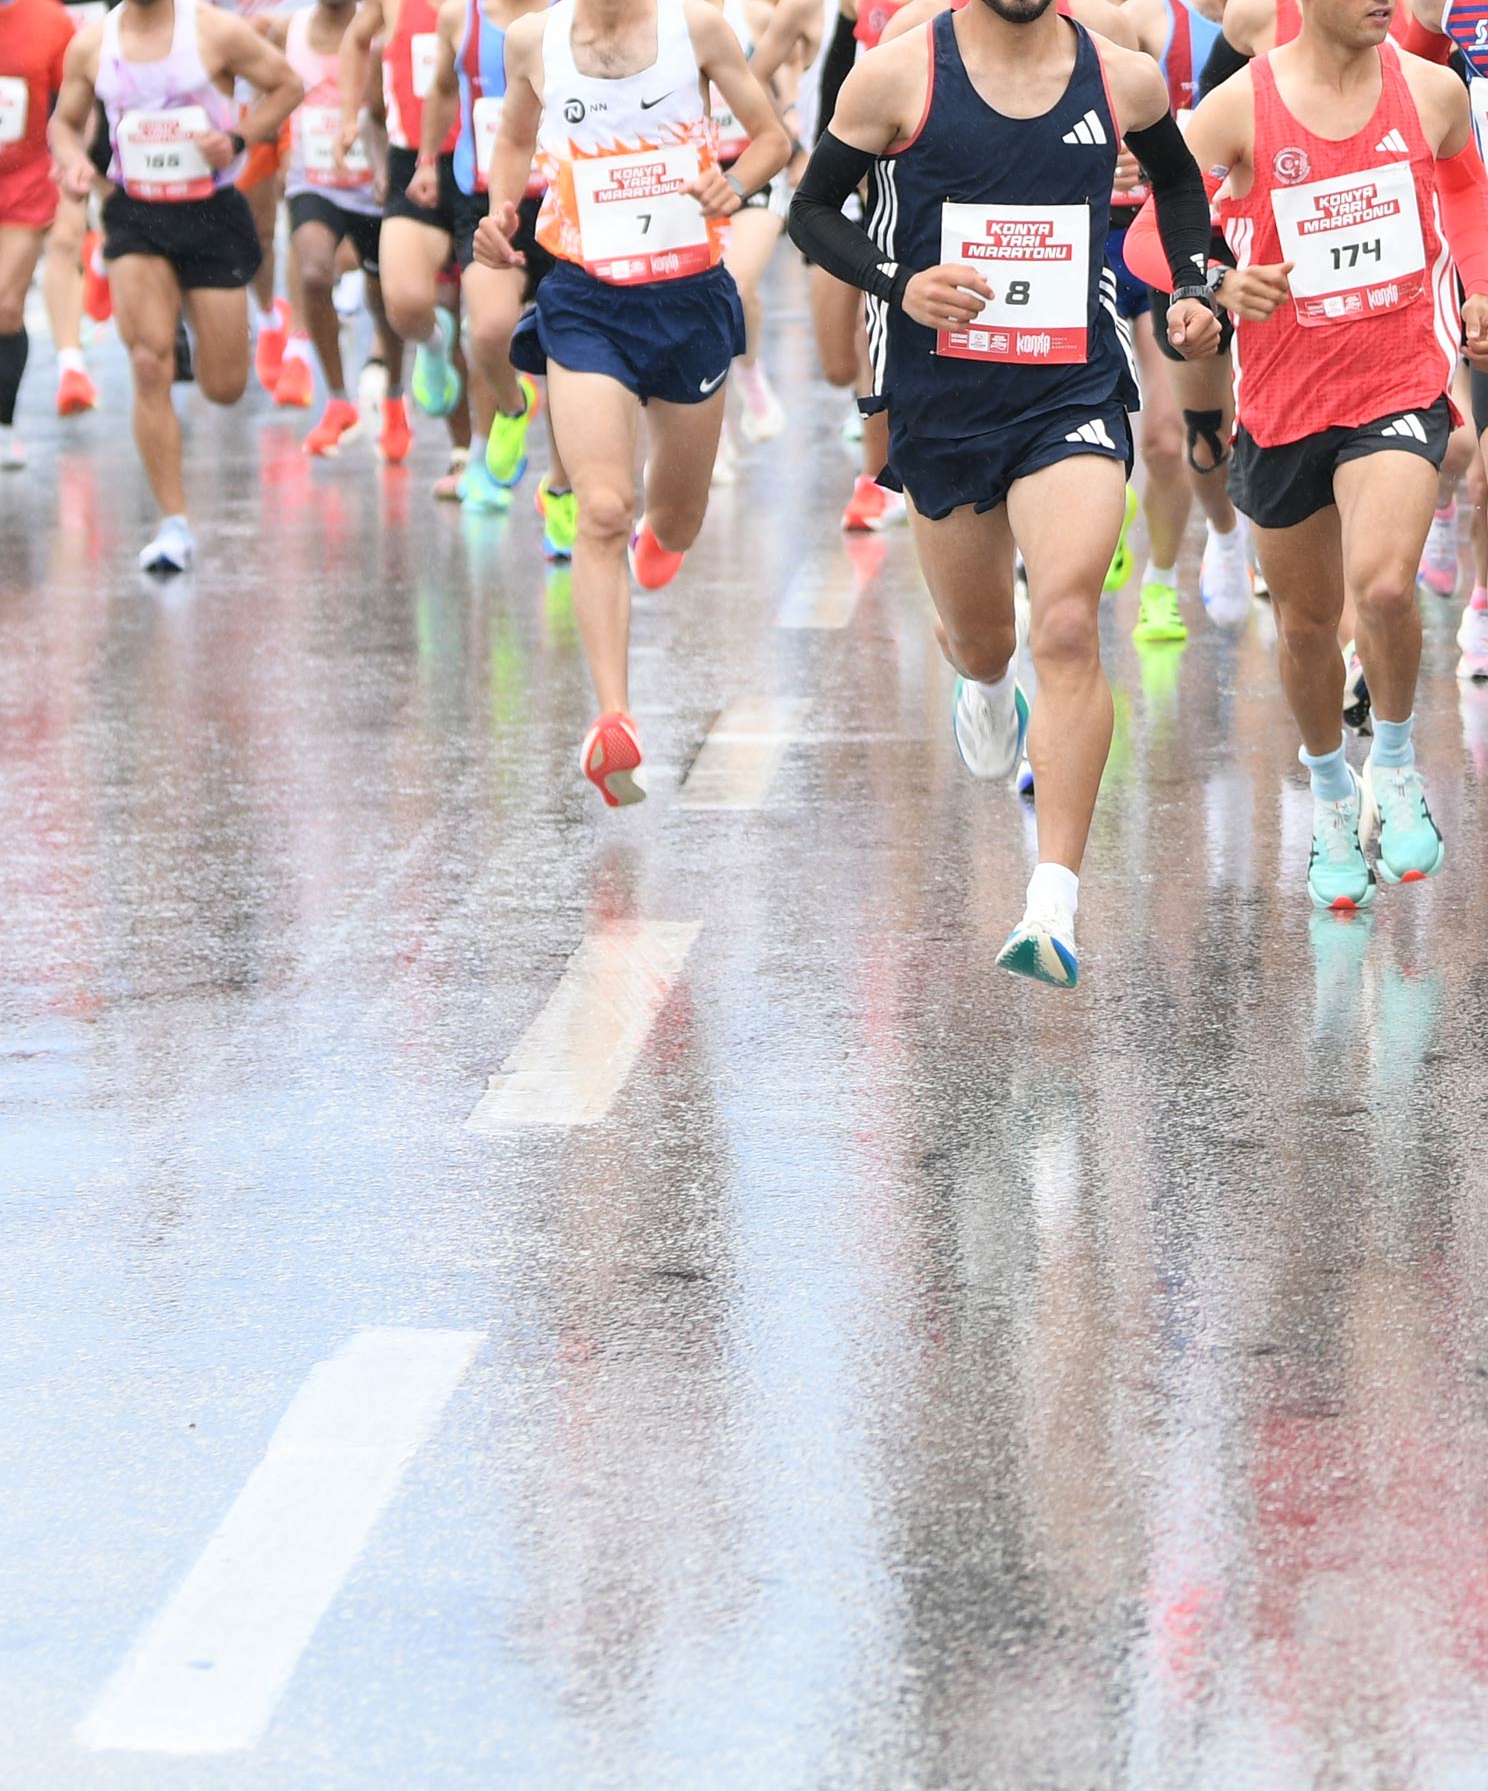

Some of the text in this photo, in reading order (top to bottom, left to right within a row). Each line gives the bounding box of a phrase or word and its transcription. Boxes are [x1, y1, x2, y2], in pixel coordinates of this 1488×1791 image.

[613, 163, 663, 181] KONYA
[597, 180, 681, 202] MARATONU
[622, 175, 657, 190] YARI
[1318, 186, 1374, 209] KONYA
[1302, 202, 1396, 235] MARATONU
[1329, 200, 1367, 218] YARI
[636, 213, 652, 235] 7
[991, 222, 1051, 235] KONYA
[999, 235, 1041, 247] YARI
[967, 244, 1067, 260] MARATONU
[1330, 237, 1382, 270] 174
[1005, 280, 1031, 306] 8
